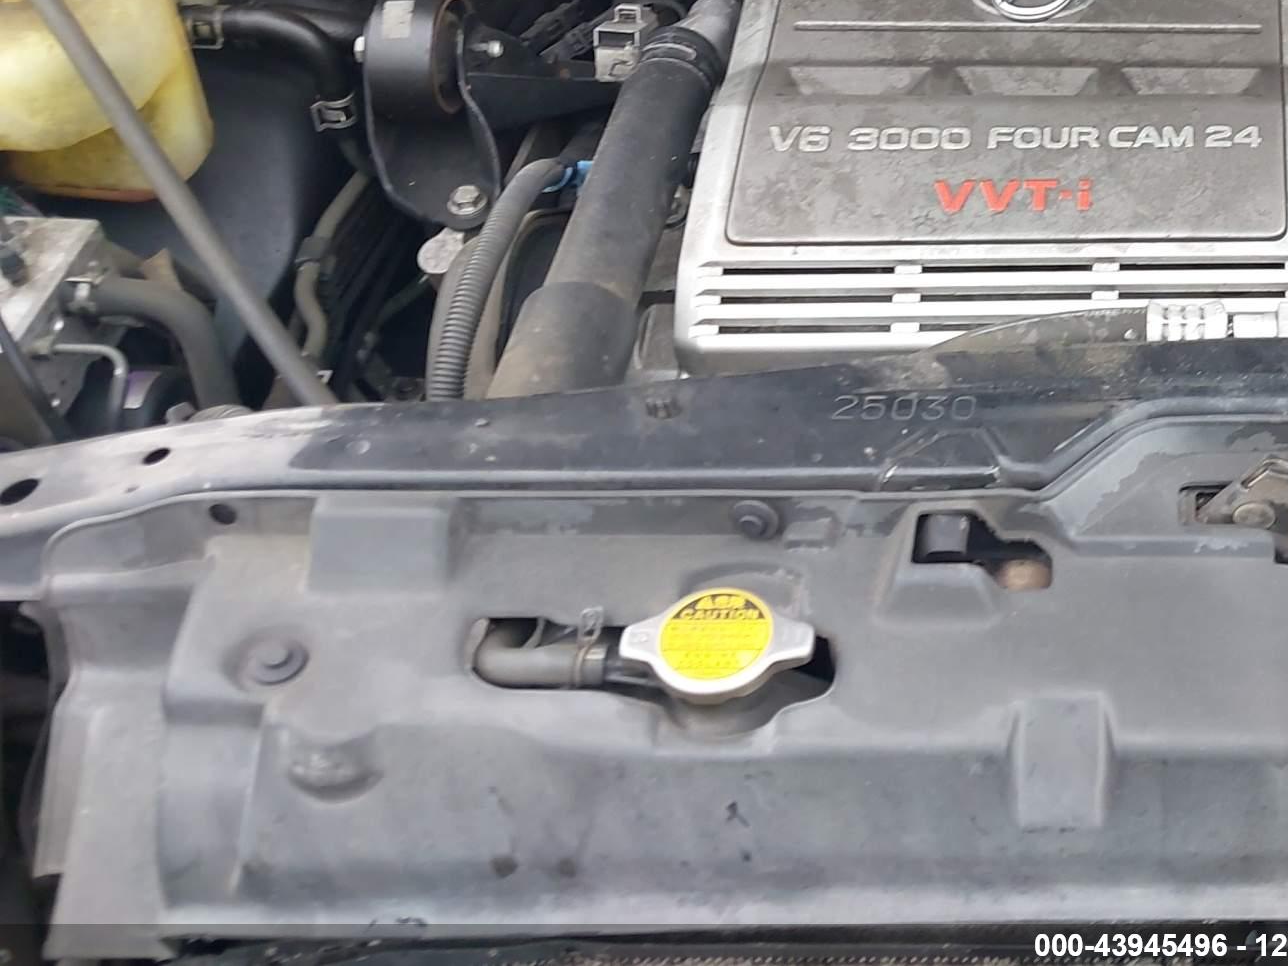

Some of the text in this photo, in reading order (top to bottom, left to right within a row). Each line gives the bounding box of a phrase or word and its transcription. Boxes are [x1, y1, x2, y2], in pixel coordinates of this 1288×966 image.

[769, 125, 1263, 152] V6 3000 FOUR CAM 24
[934, 177, 1094, 214] VVT-i
[831, 394, 977, 421] 25030
